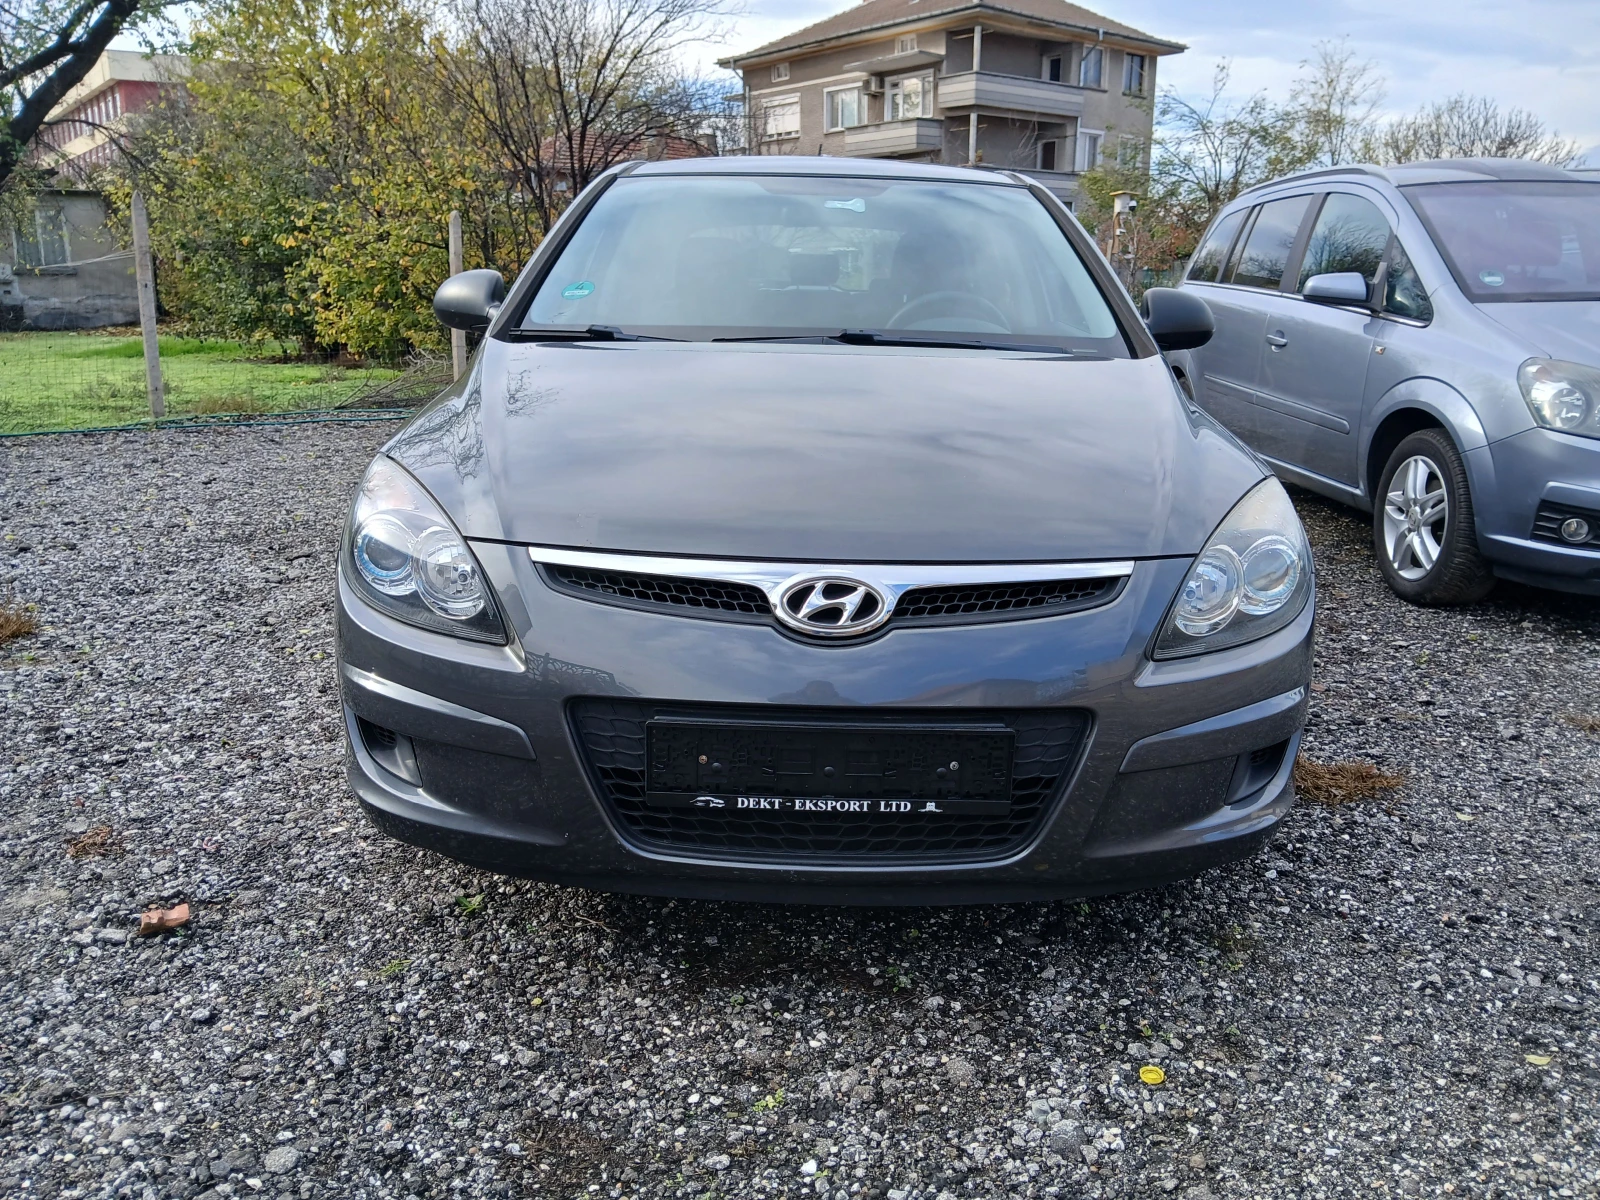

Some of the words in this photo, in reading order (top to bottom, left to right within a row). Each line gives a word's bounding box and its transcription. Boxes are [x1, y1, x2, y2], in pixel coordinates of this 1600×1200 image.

[737, 797, 783, 809] DEKT
[794, 799, 871, 812] EKSPORT
[880, 801, 911, 812] LTD
